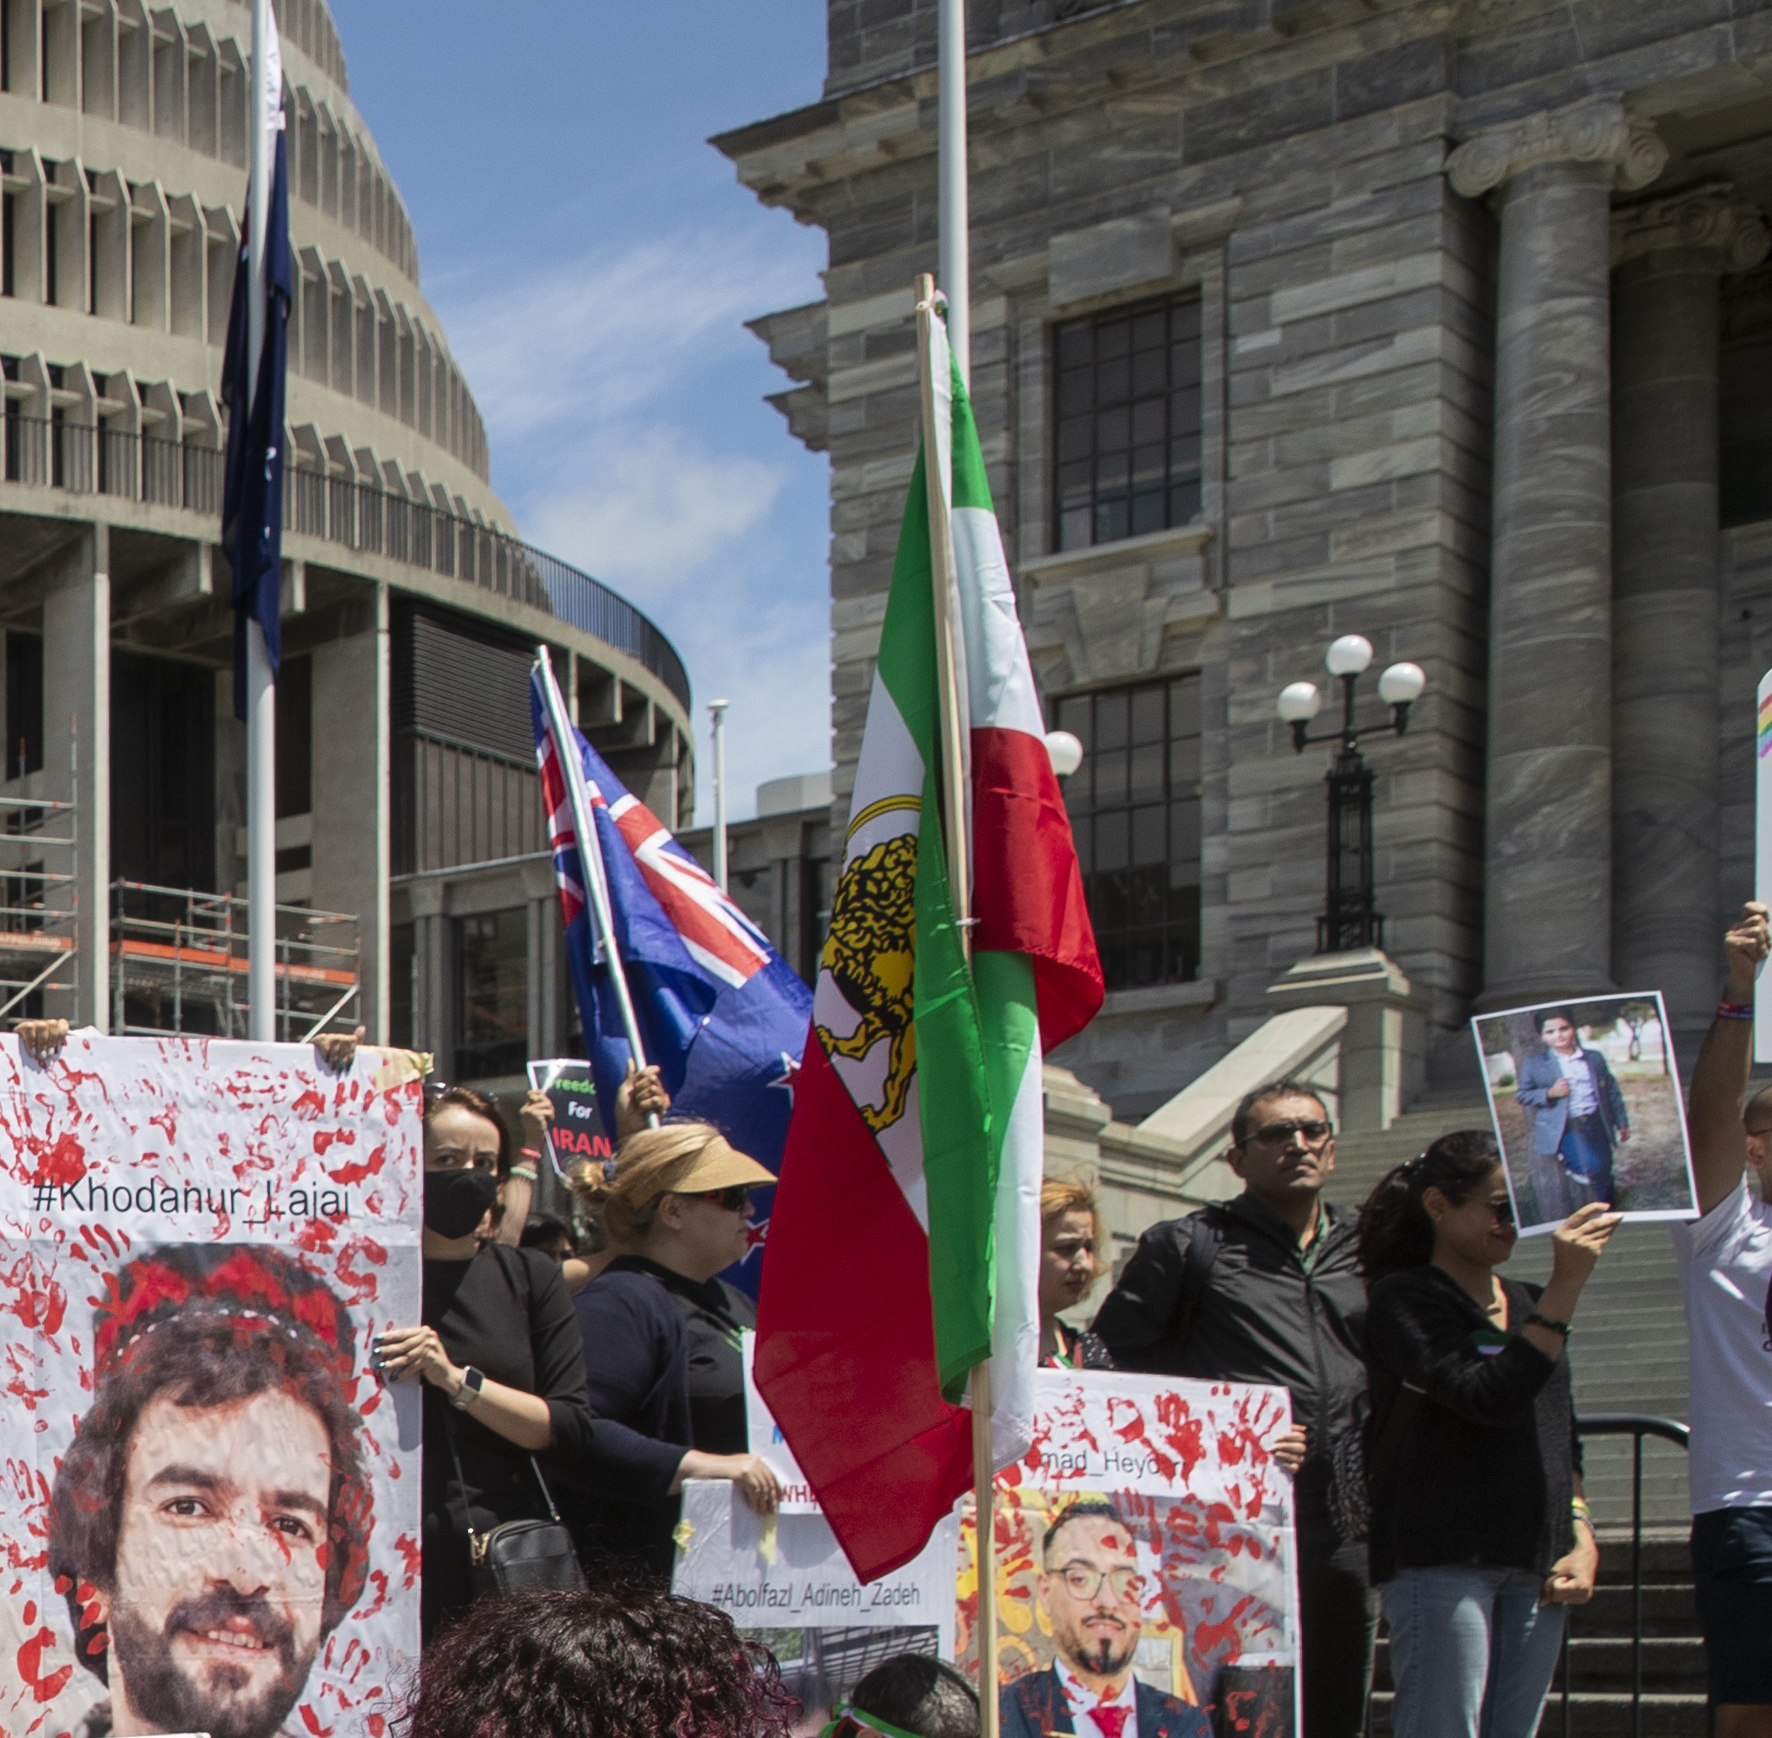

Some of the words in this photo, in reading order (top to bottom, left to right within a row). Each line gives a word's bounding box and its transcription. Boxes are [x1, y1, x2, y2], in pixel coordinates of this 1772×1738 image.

[568, 1100, 593, 1120] For
[552, 1126, 612, 1158] IRAN
[33, 1177, 350, 1225] #Khodanur_Lajai
[711, 1581, 920, 1614] #Abolfazl_Adineh_Zadeh
